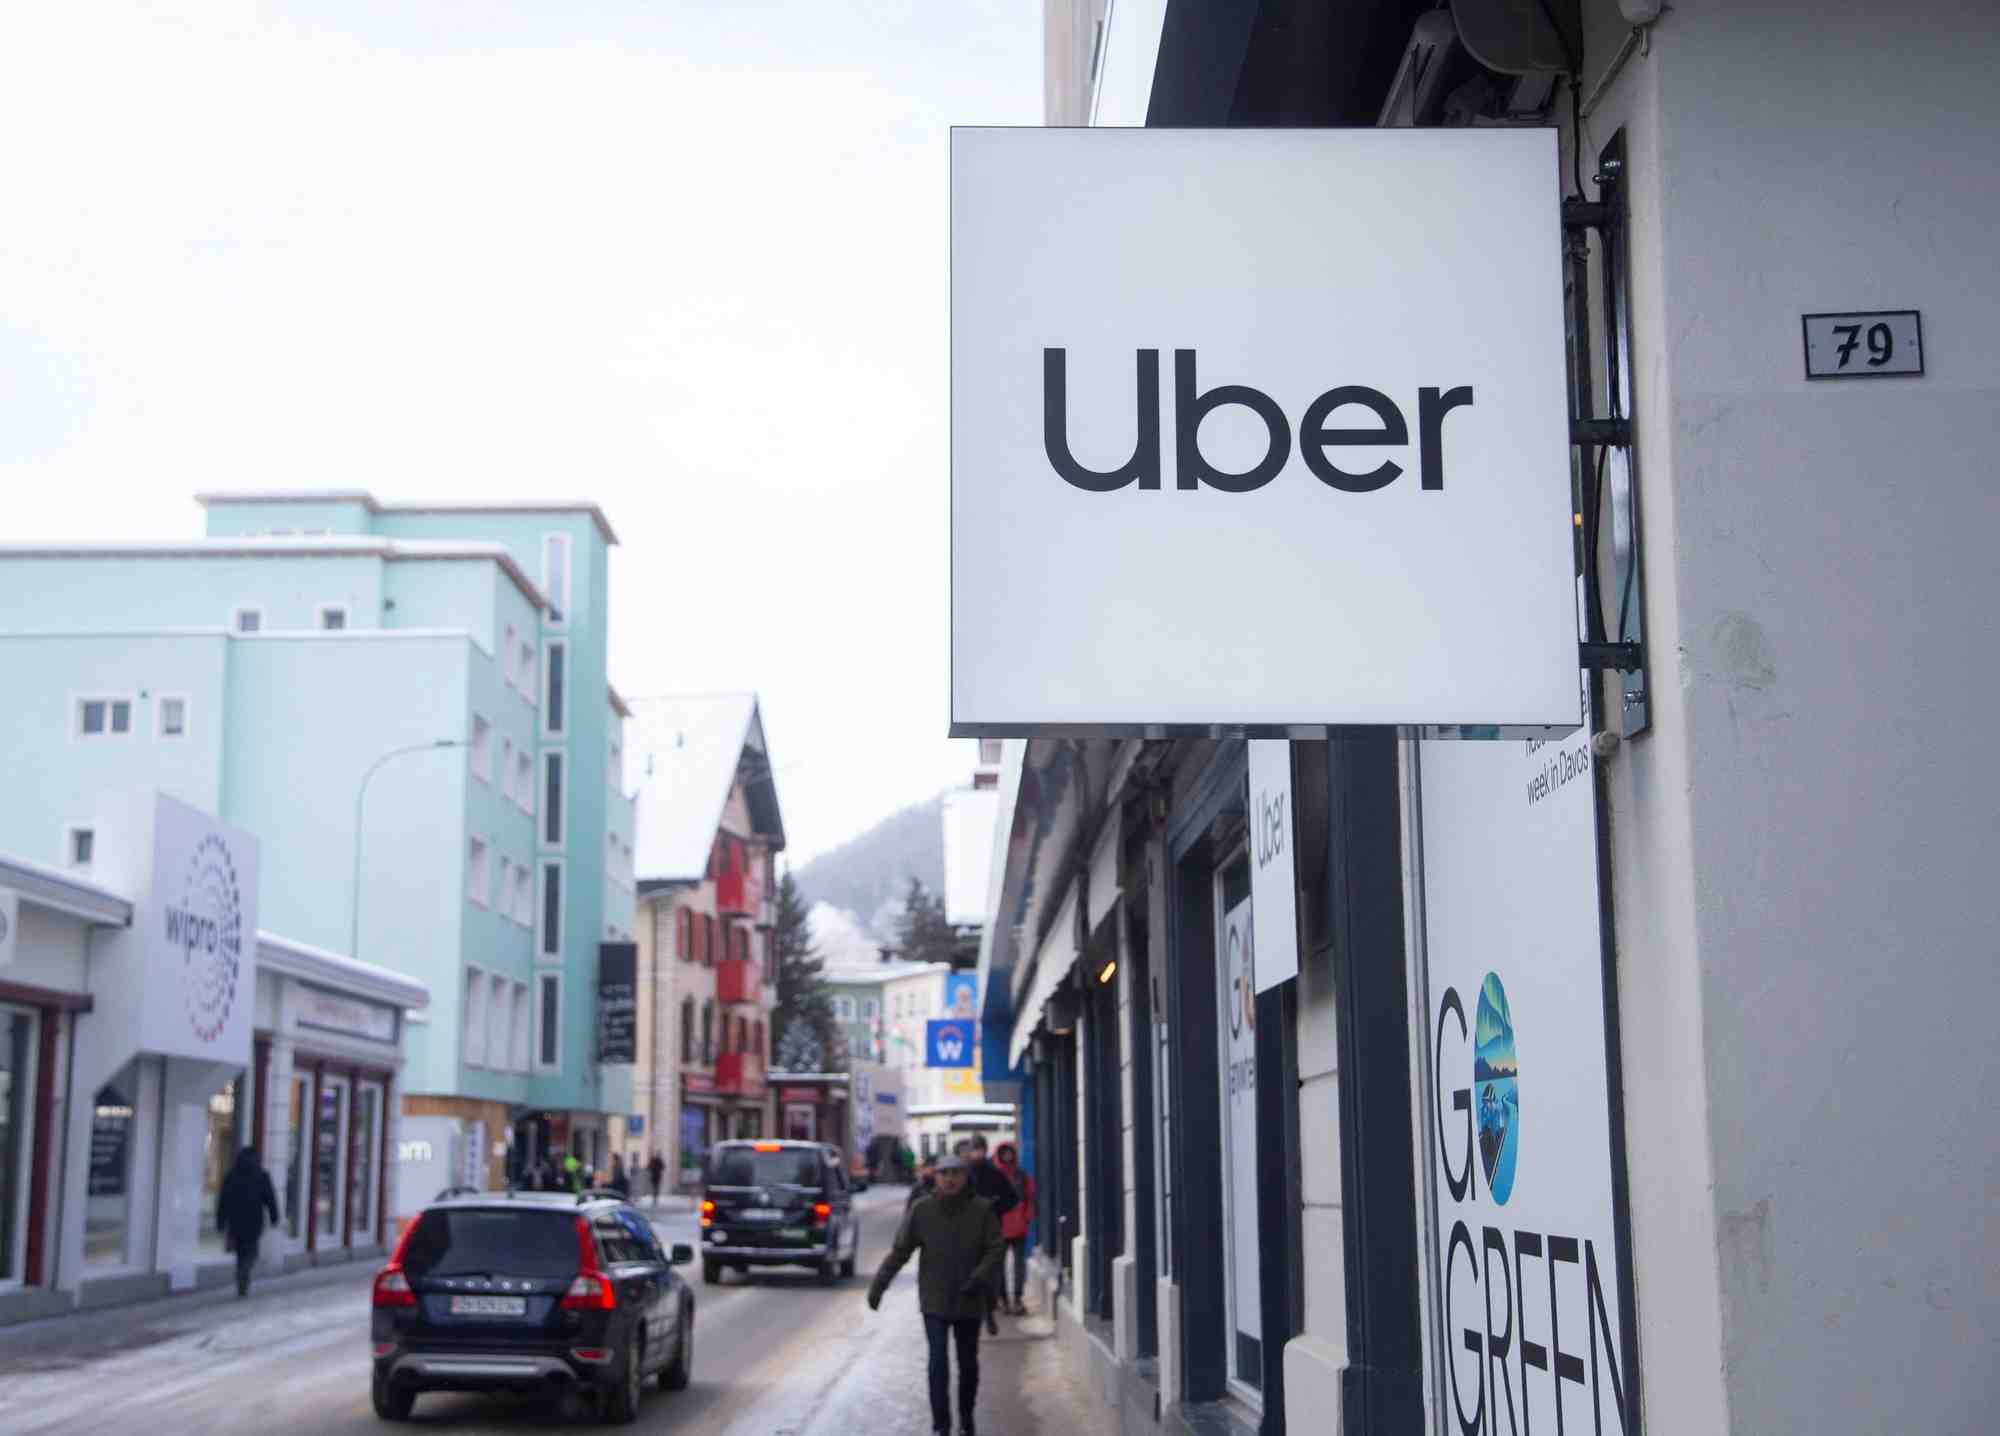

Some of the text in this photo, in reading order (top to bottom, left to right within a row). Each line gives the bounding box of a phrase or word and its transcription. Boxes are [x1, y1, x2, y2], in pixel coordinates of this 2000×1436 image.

[1832, 322, 1893, 369] 79
[1043, 347, 1474, 493] Uber
[1527, 762, 1550, 807] week
[1550, 758, 1559, 792] in
[1559, 743, 1589, 785] Davos
[1255, 787, 1285, 871] Uber
[164, 904, 218, 965] wipro
